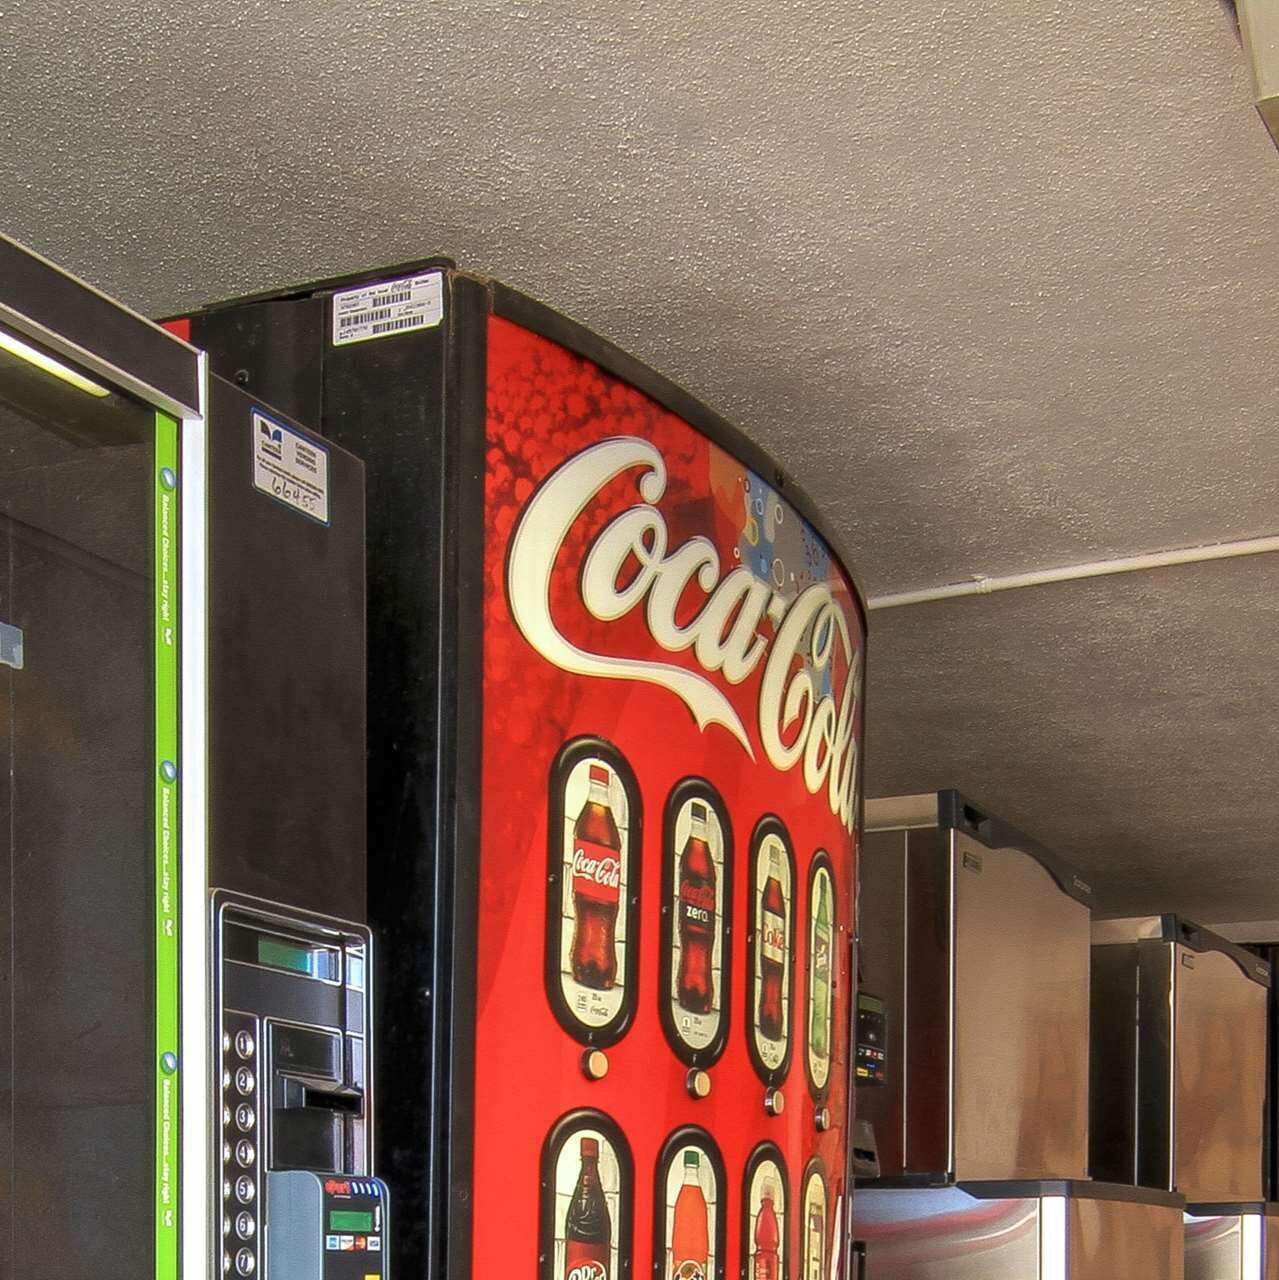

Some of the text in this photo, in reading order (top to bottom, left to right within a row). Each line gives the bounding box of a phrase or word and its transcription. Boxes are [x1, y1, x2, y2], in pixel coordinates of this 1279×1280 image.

[508, 434, 863, 838] Coca-Cola
[572, 847, 621, 889] Coca-Cola
[686, 904, 710, 923] zero
[762, 919, 785, 949] Coke
[239, 1037, 245, 1050] 1
[239, 1075, 246, 1087] 2
[239, 1111, 247, 1123] 3
[239, 1147, 247, 1160] 4
[239, 1183, 247, 1195] 5
[239, 1219, 247, 1231] 6
[240, 1256, 247, 1269] 7
[580, 1265, 596, 1280] Dr
